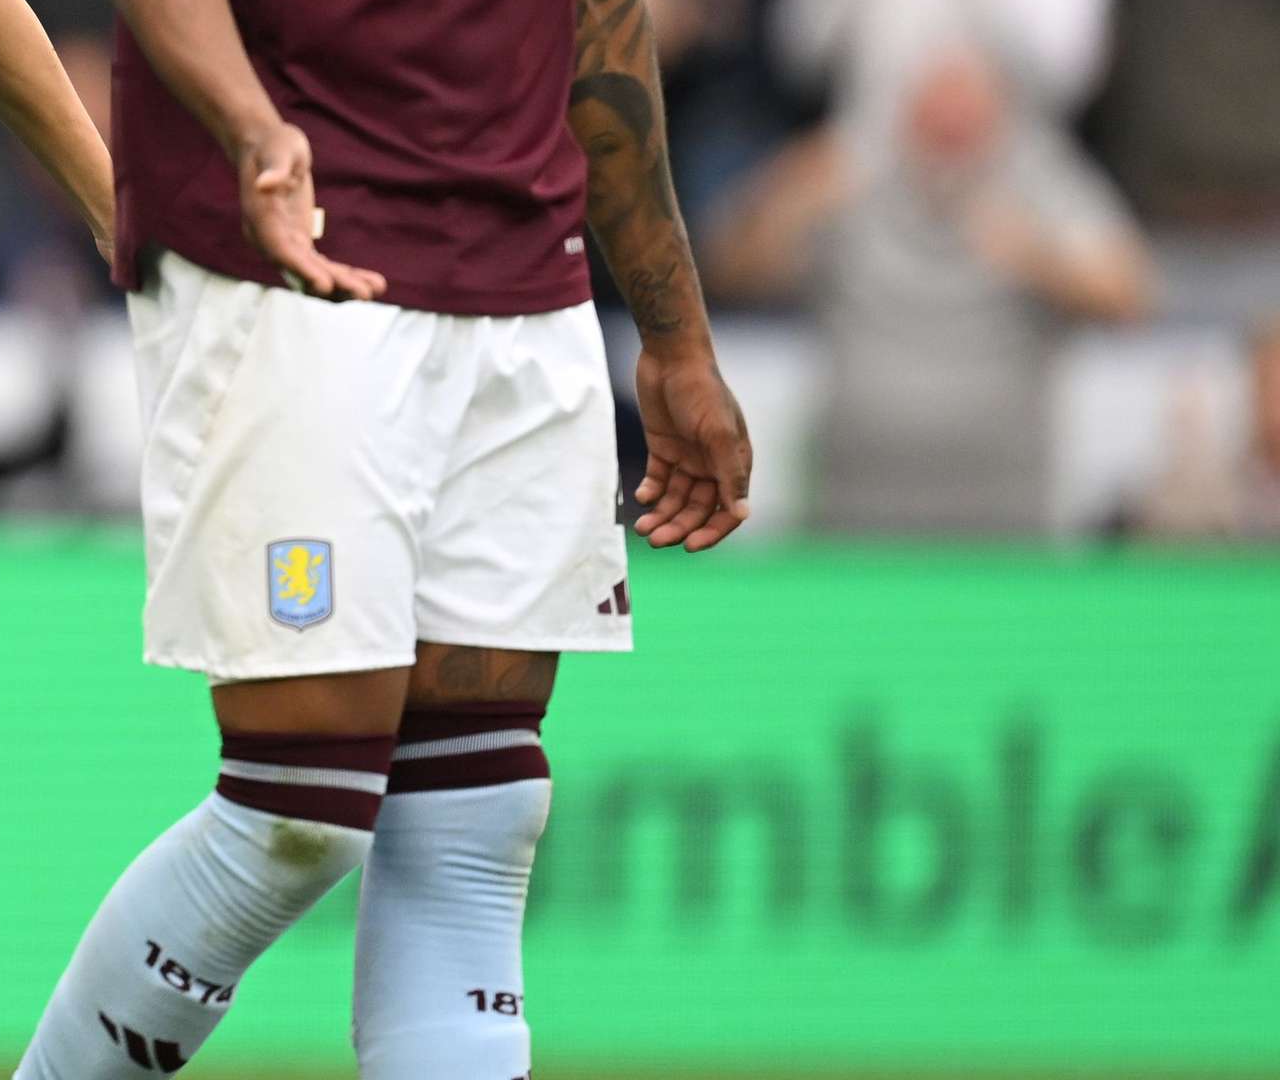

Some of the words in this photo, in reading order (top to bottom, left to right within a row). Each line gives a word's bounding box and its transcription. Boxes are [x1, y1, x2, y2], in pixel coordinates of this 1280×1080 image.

[540, 705, 1280, 945] mble
[145, 939, 235, 1004] 1874
[466, 989, 524, 1016] 18
